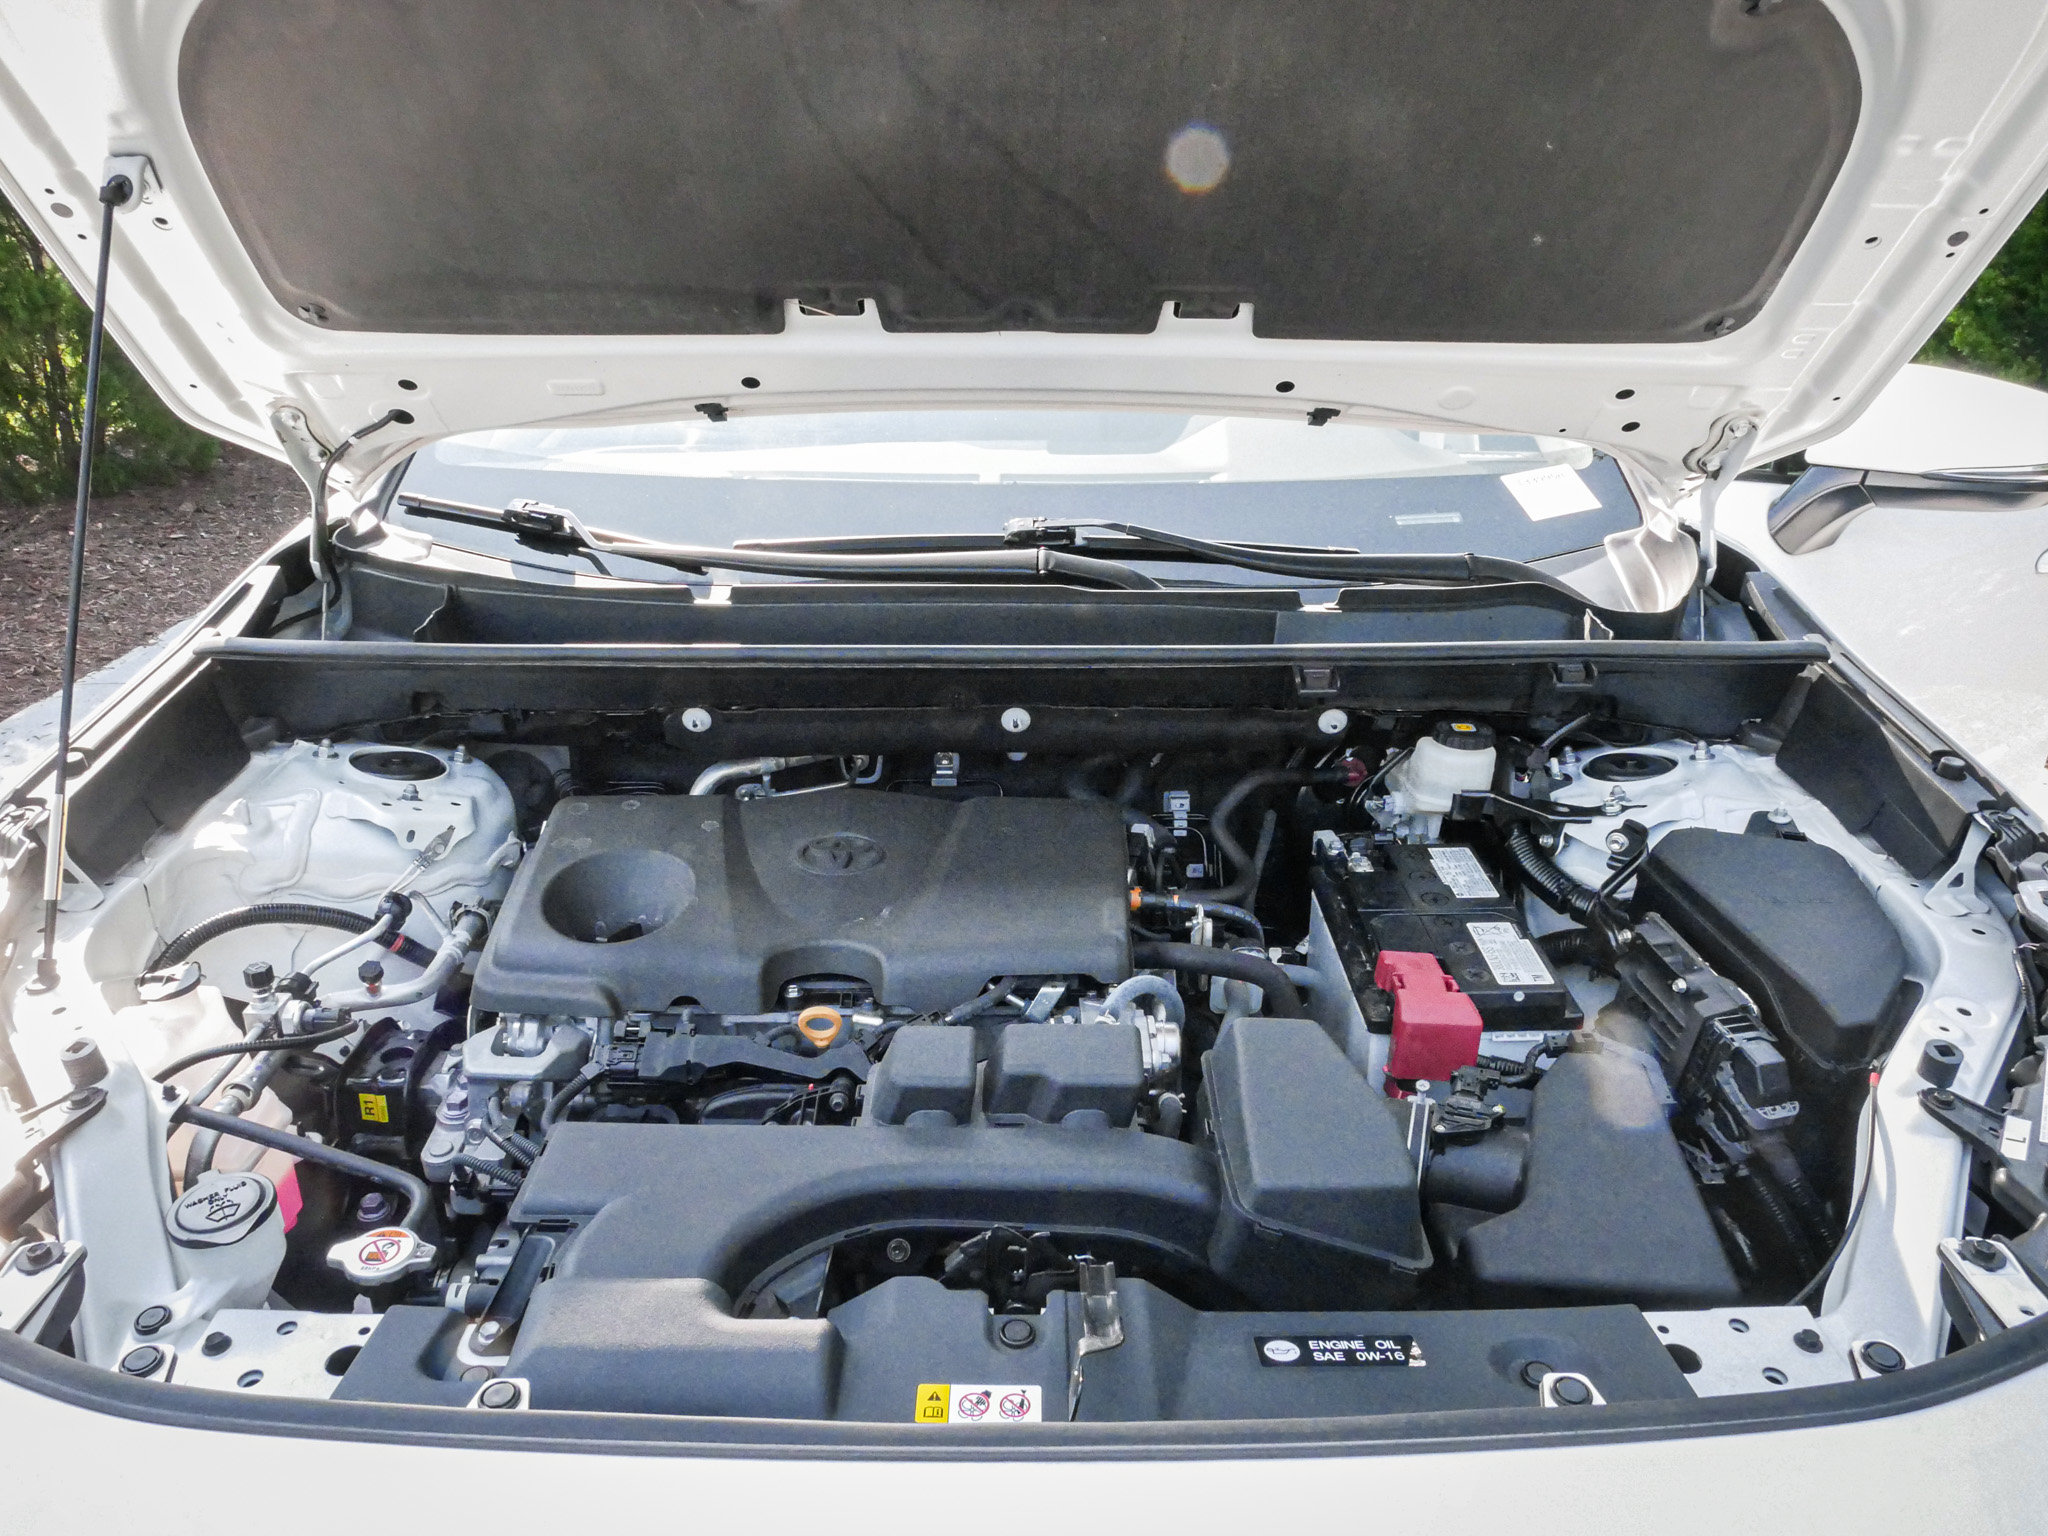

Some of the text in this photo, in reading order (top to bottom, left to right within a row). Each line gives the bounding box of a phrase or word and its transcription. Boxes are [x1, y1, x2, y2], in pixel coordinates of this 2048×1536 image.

[363, 1100, 375, 1116] R1
[184, 1180, 247, 1209] WASHER FLUID
[207, 1193, 228, 1205] ONLY
[1308, 1340, 1402, 1350] ENGINE OIL
[1313, 1351, 1406, 1361] SAE 0W-16
